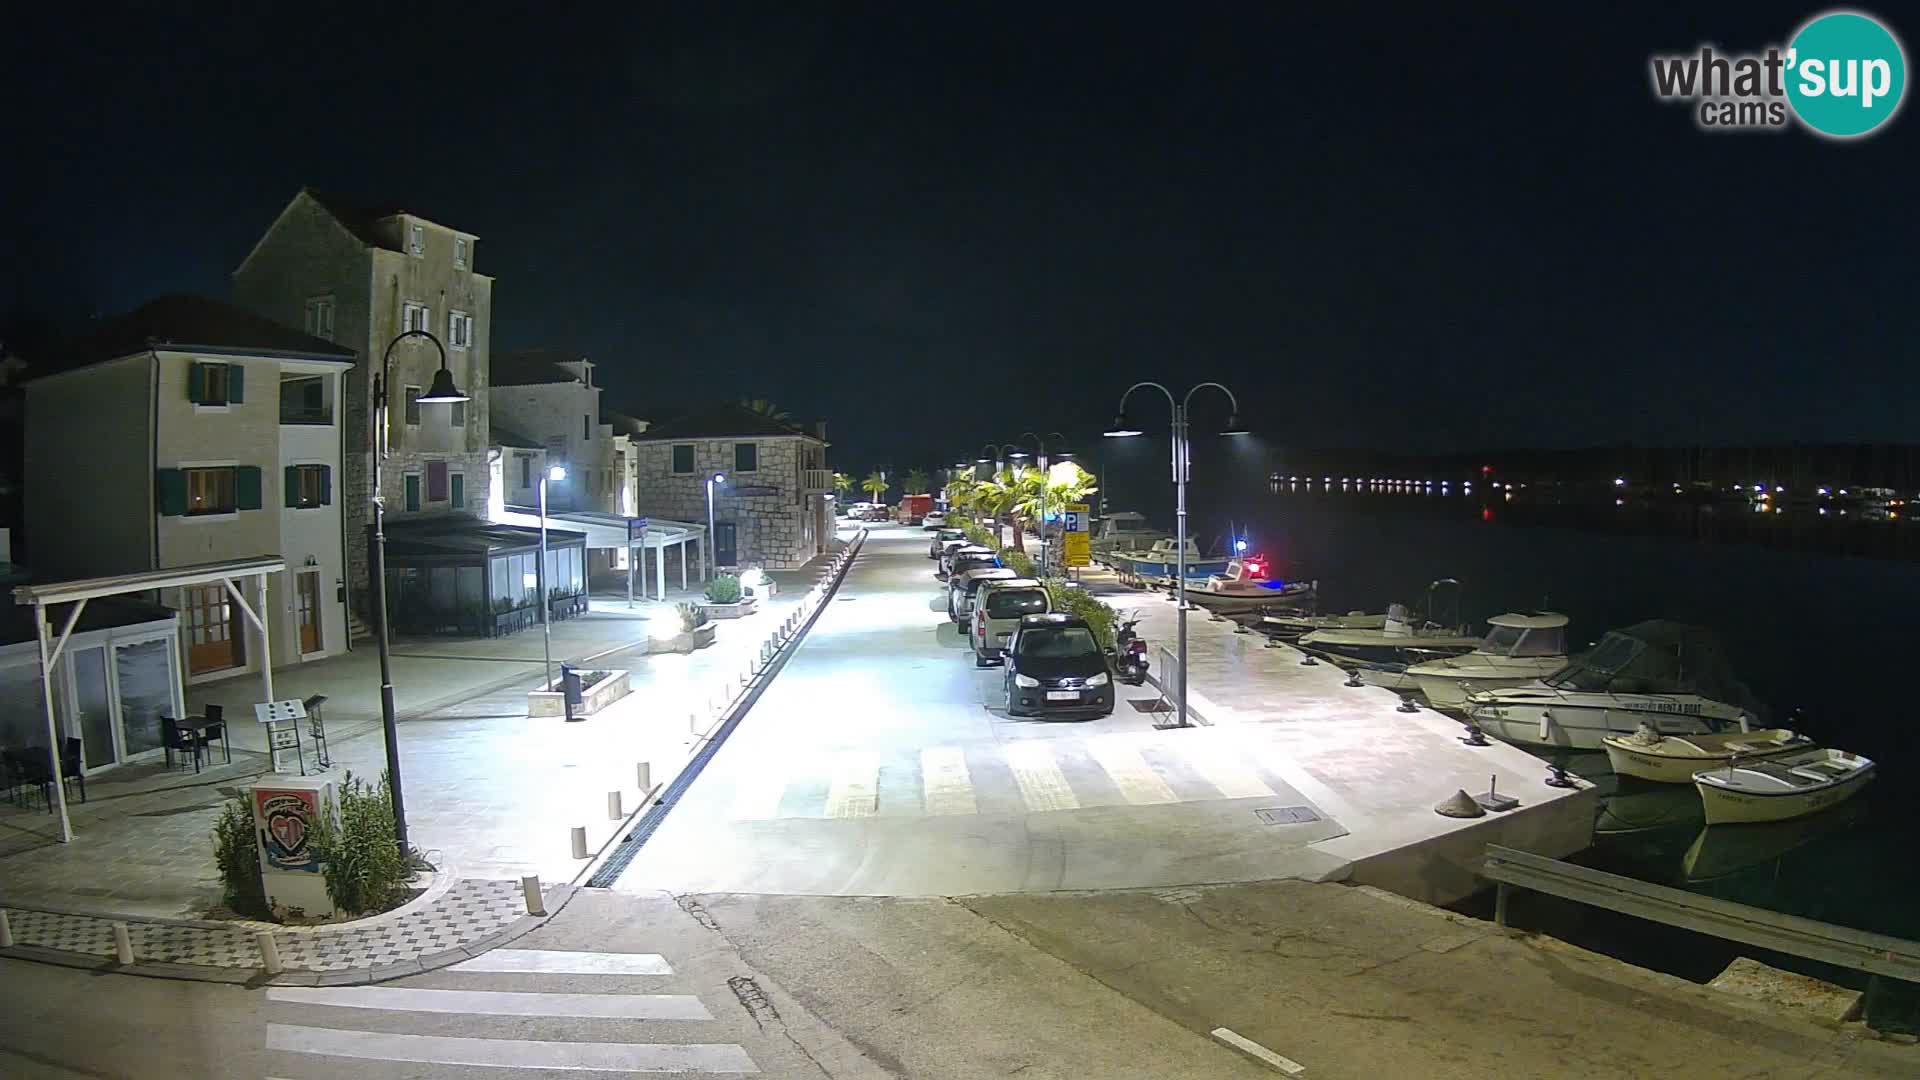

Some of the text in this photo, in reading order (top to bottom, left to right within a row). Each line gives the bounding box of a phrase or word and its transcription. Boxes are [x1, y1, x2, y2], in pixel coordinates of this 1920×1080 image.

[1066, 514, 1077, 530] P
[1657, 703, 1676, 712] RENT
[1683, 704, 1702, 714] BOAT
